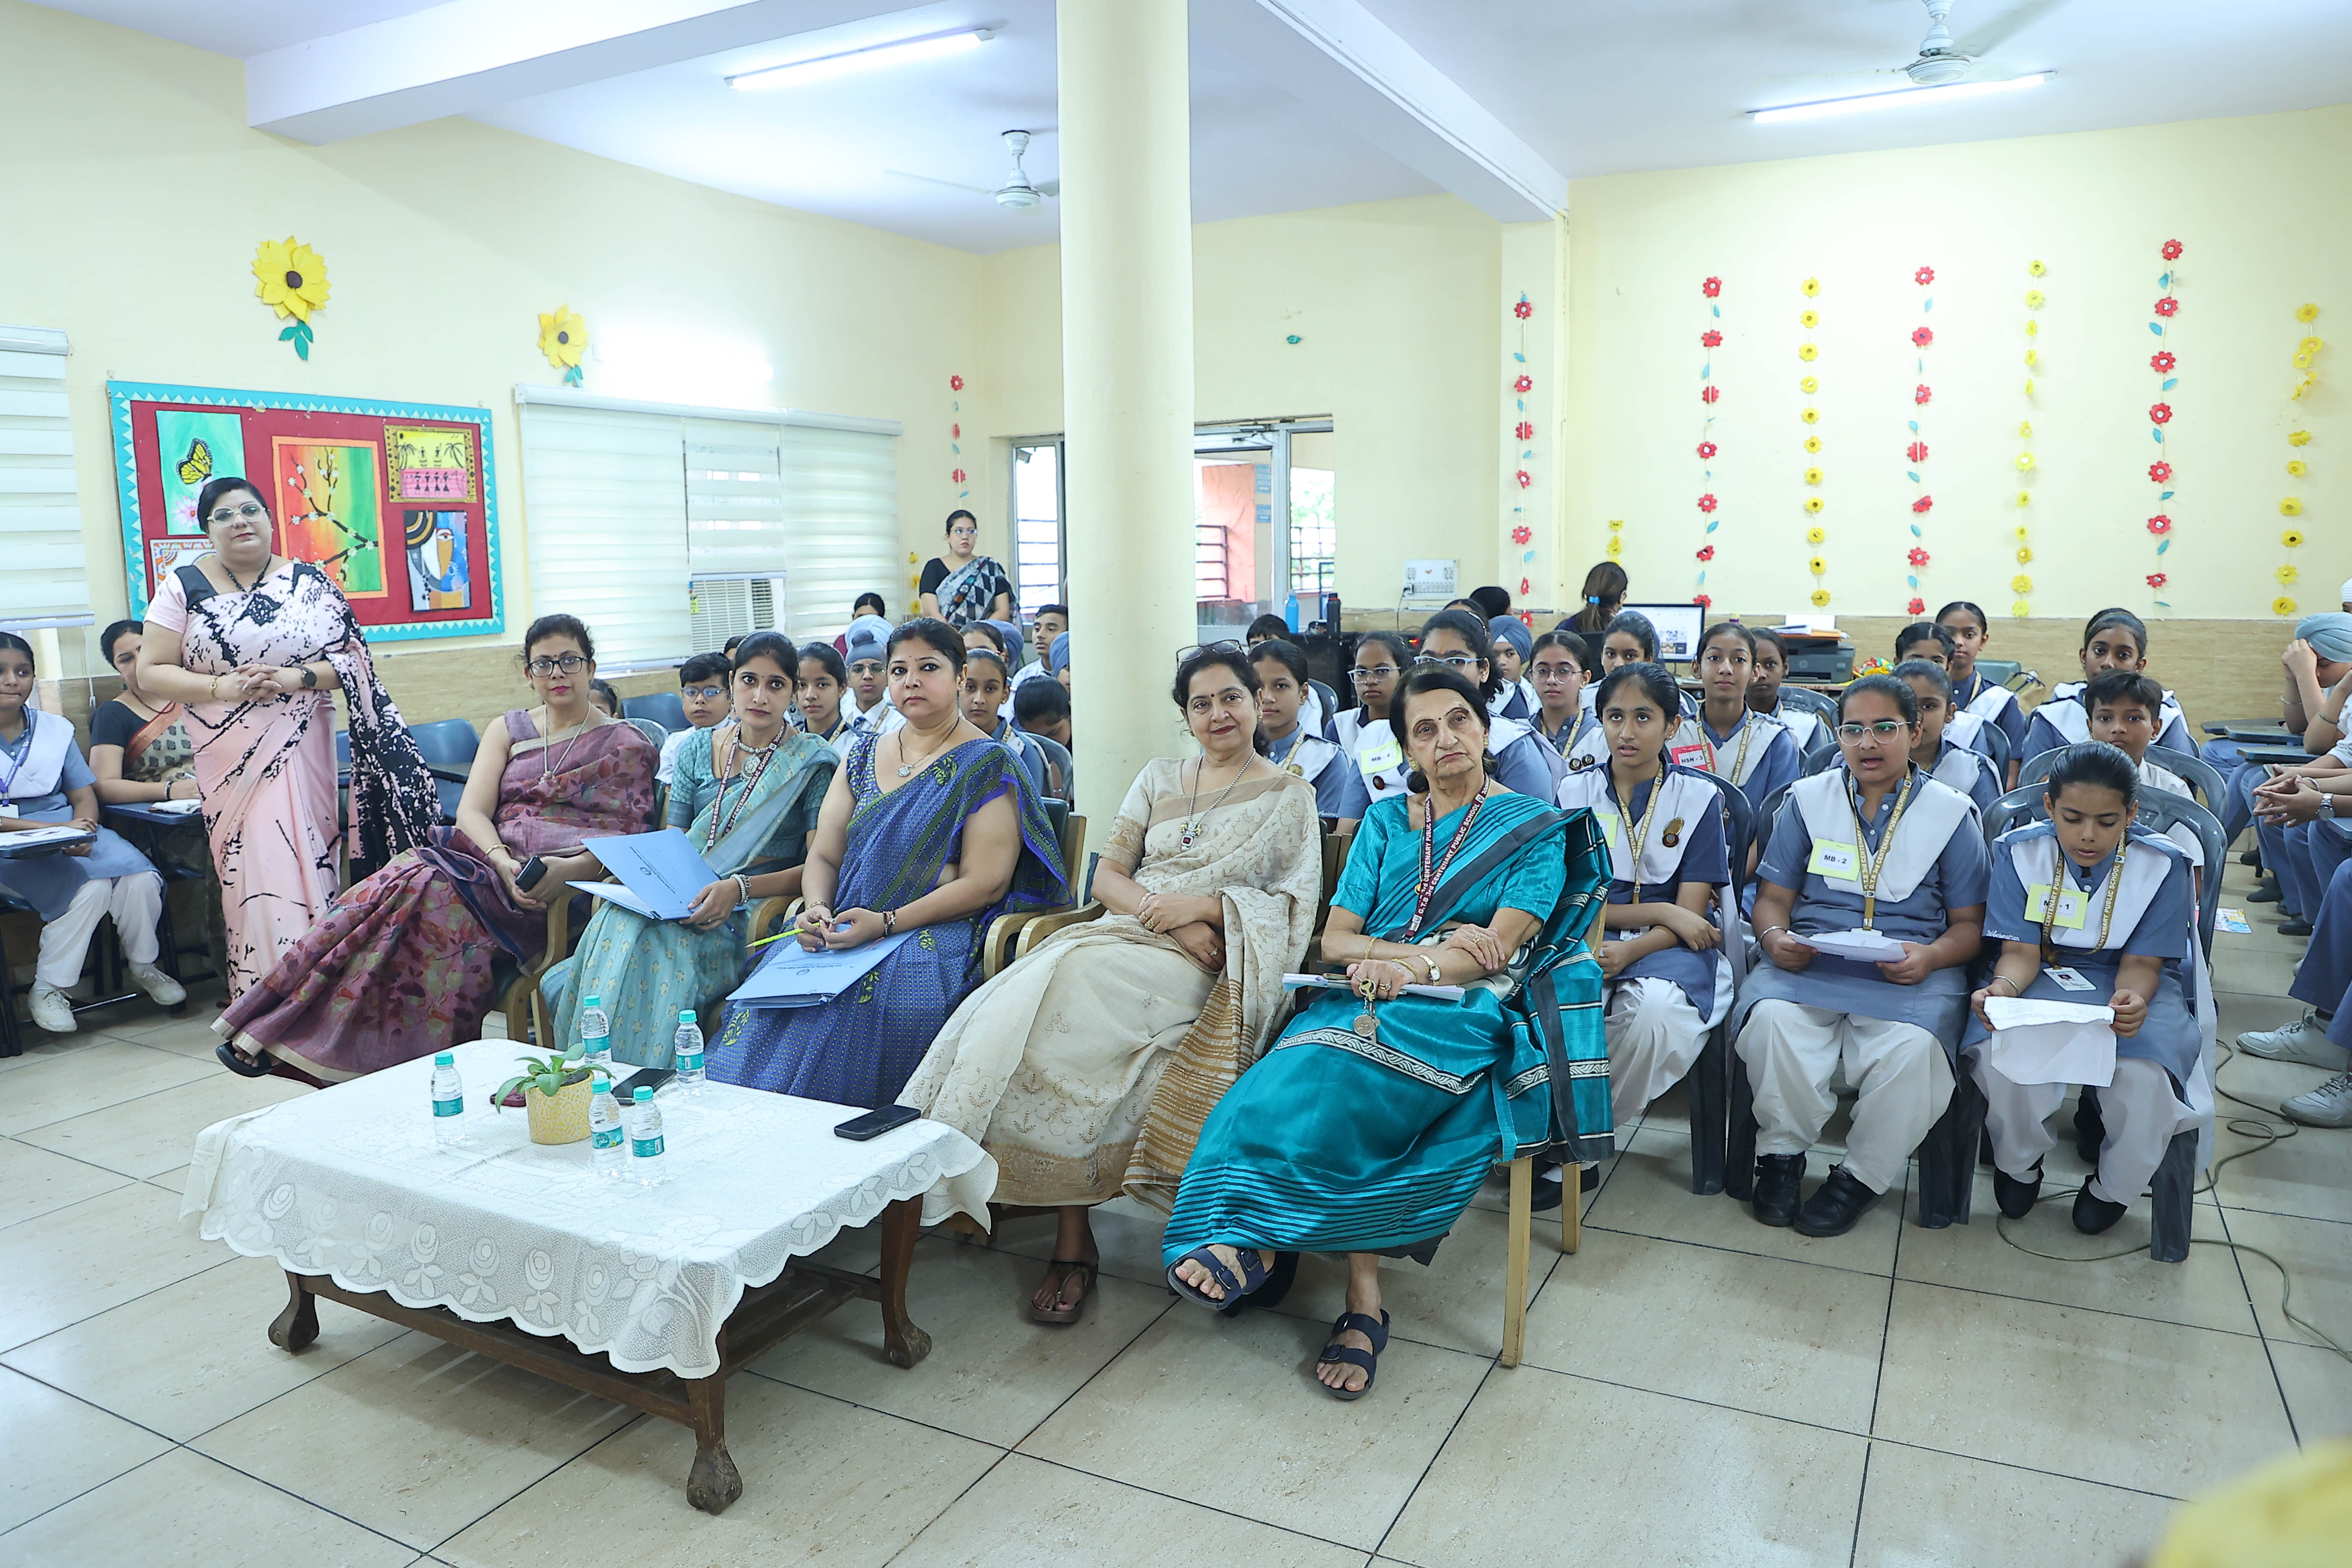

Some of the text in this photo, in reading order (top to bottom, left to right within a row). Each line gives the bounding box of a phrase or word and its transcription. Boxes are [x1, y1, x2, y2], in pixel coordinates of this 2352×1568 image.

[714, 784, 726, 815] CENTENARY
[722, 765, 731, 783] PUBLIC
[732, 789, 750, 818] CENTENARY
[749, 770, 761, 789] PUBLIC
[759, 750, 772, 771] SCHOOL
[1622, 807, 1632, 827] PUBLIC
[1636, 786, 1660, 860] CENTENARY PUBLIC SCHOOL
[1877, 830, 1892, 864] CENTENARY
[1888, 811, 1900, 831] PUBLIC
[1896, 788, 1908, 810] SCHOOL
[1418, 803, 1480, 914] G.T.B 3rd CENTENARY PUBLIC SCHOOL
[1857, 830, 1866, 863] CENTENARY
[2044, 891, 2058, 926] CENTENARY
[2053, 868, 2061, 891] PUBLIC
[2104, 889, 2114, 914] PUBLIC
[2108, 864, 2120, 889] SCHOOL
